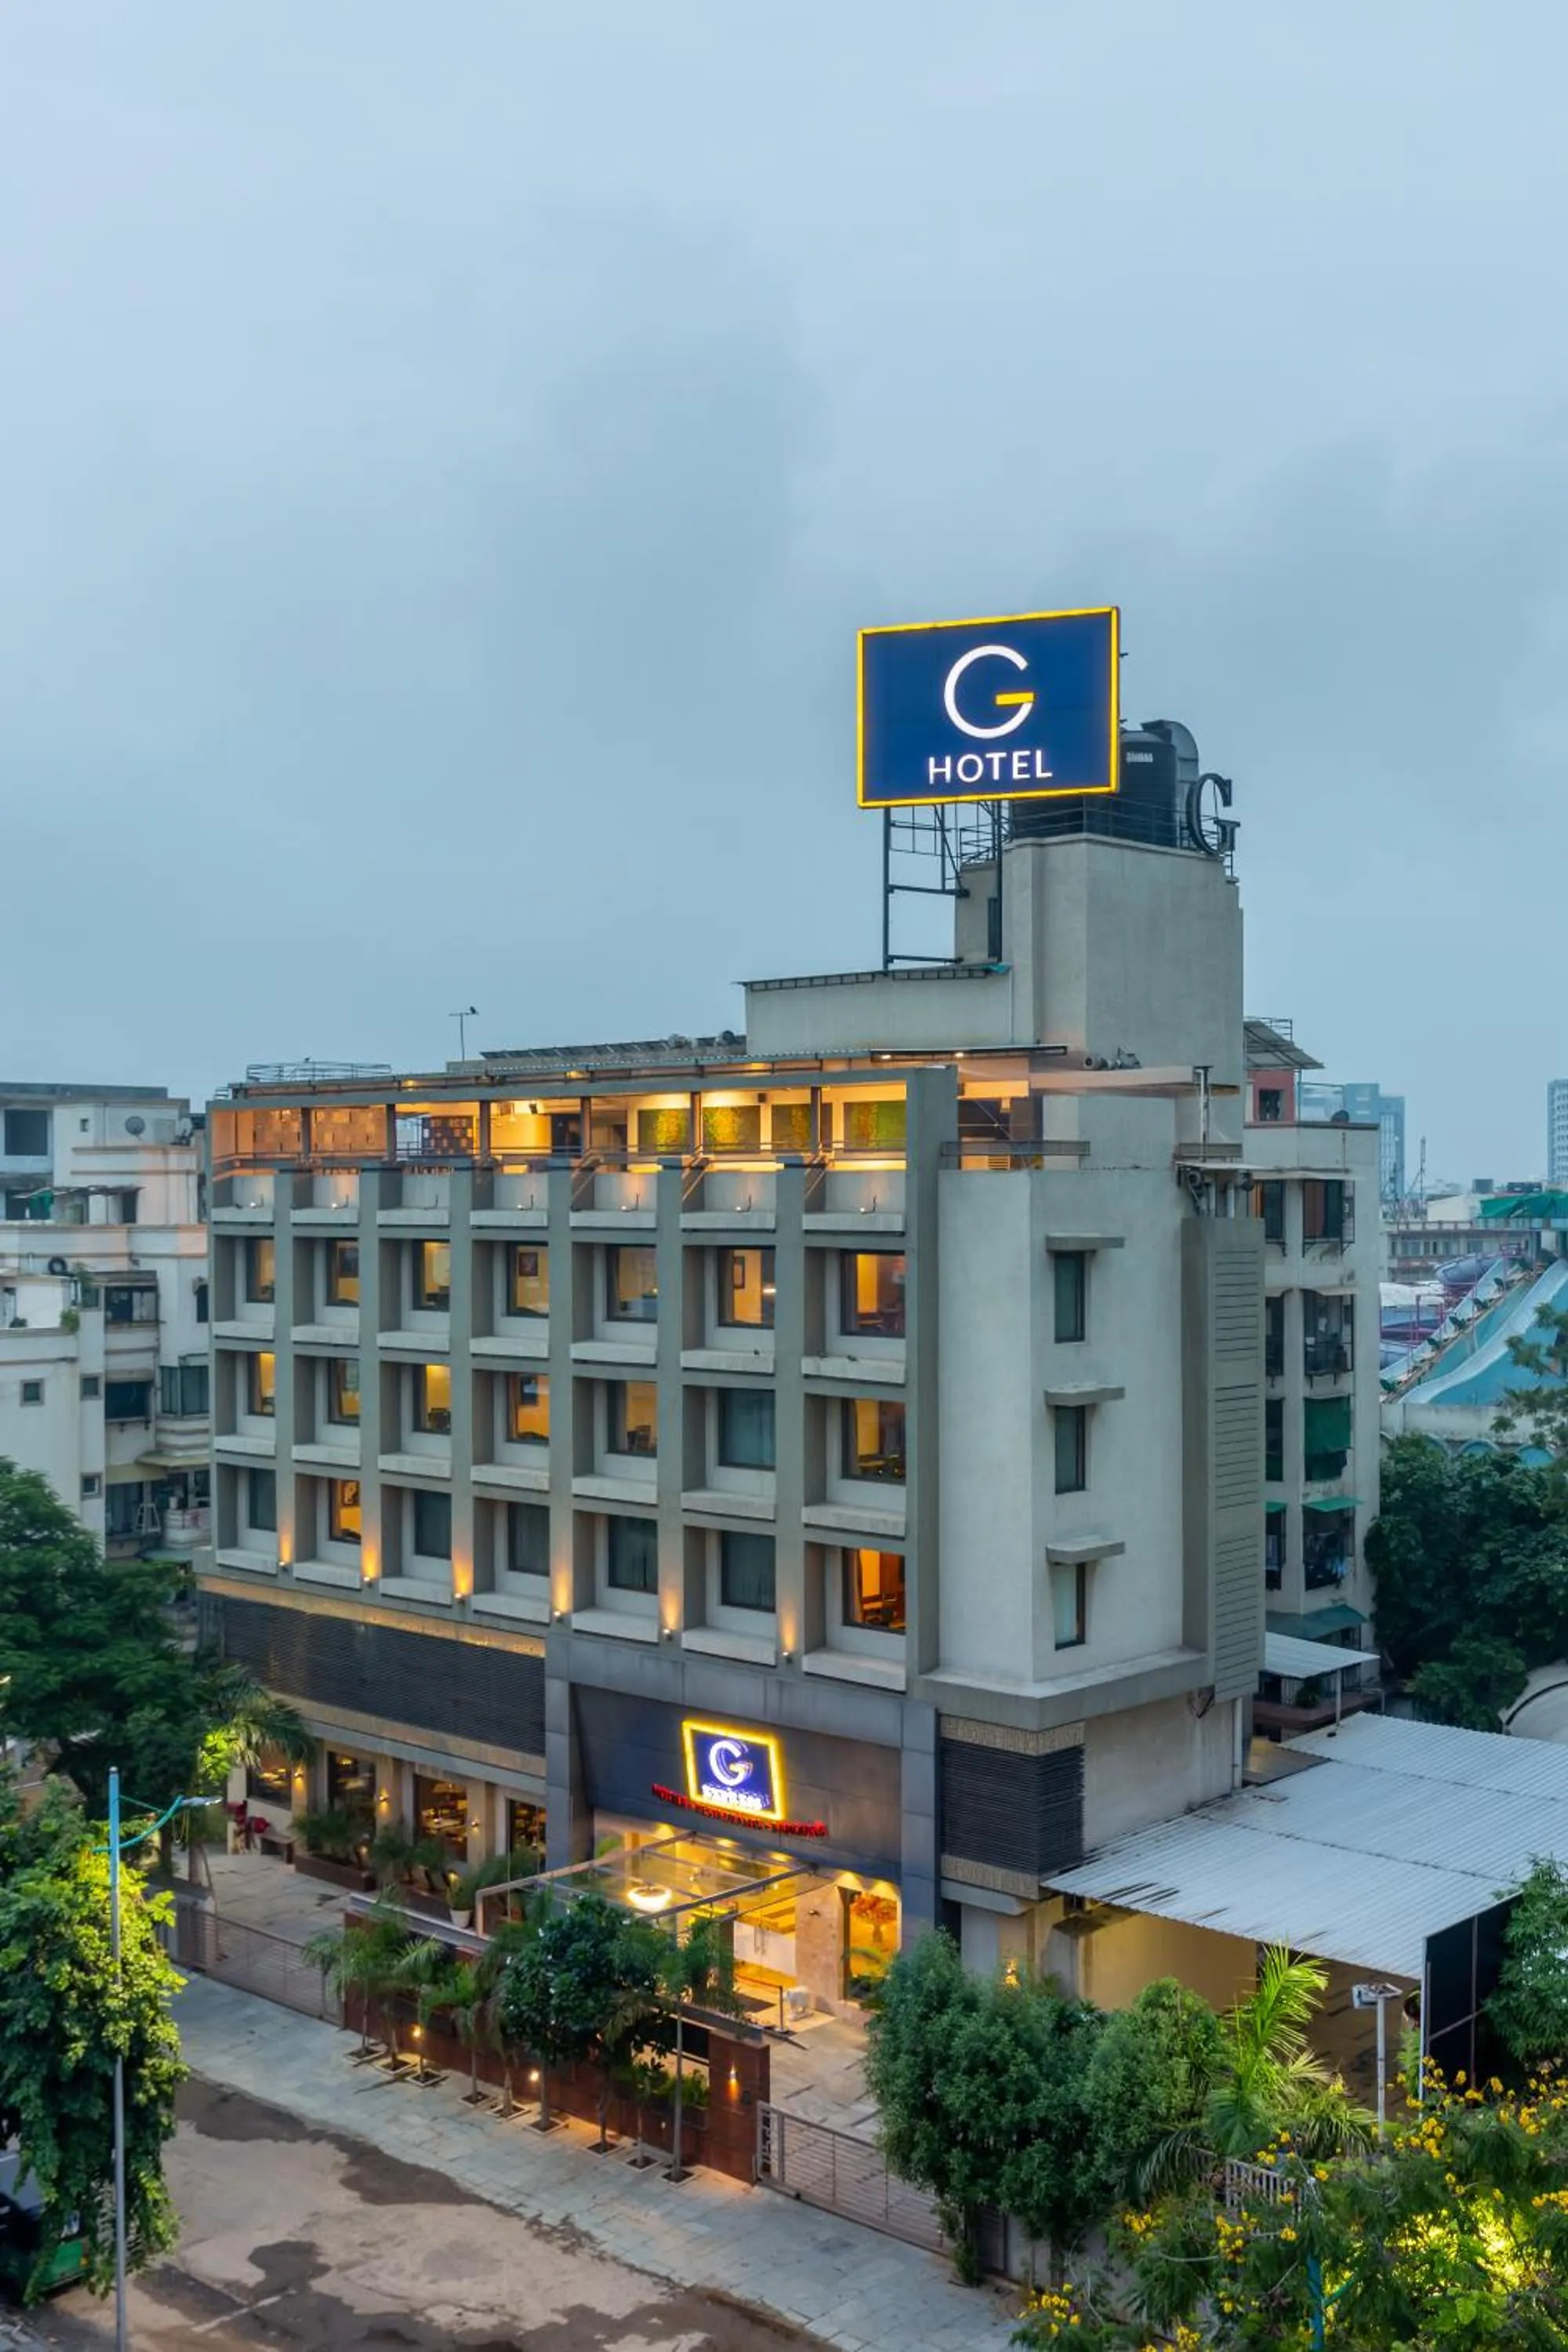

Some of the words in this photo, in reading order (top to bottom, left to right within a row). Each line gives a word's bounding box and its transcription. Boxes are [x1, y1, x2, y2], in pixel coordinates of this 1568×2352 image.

[944, 644, 1034, 739] G
[928, 749, 1053, 785] HOTEL
[1185, 772, 1241, 856] G
[709, 1739, 750, 1786] G
